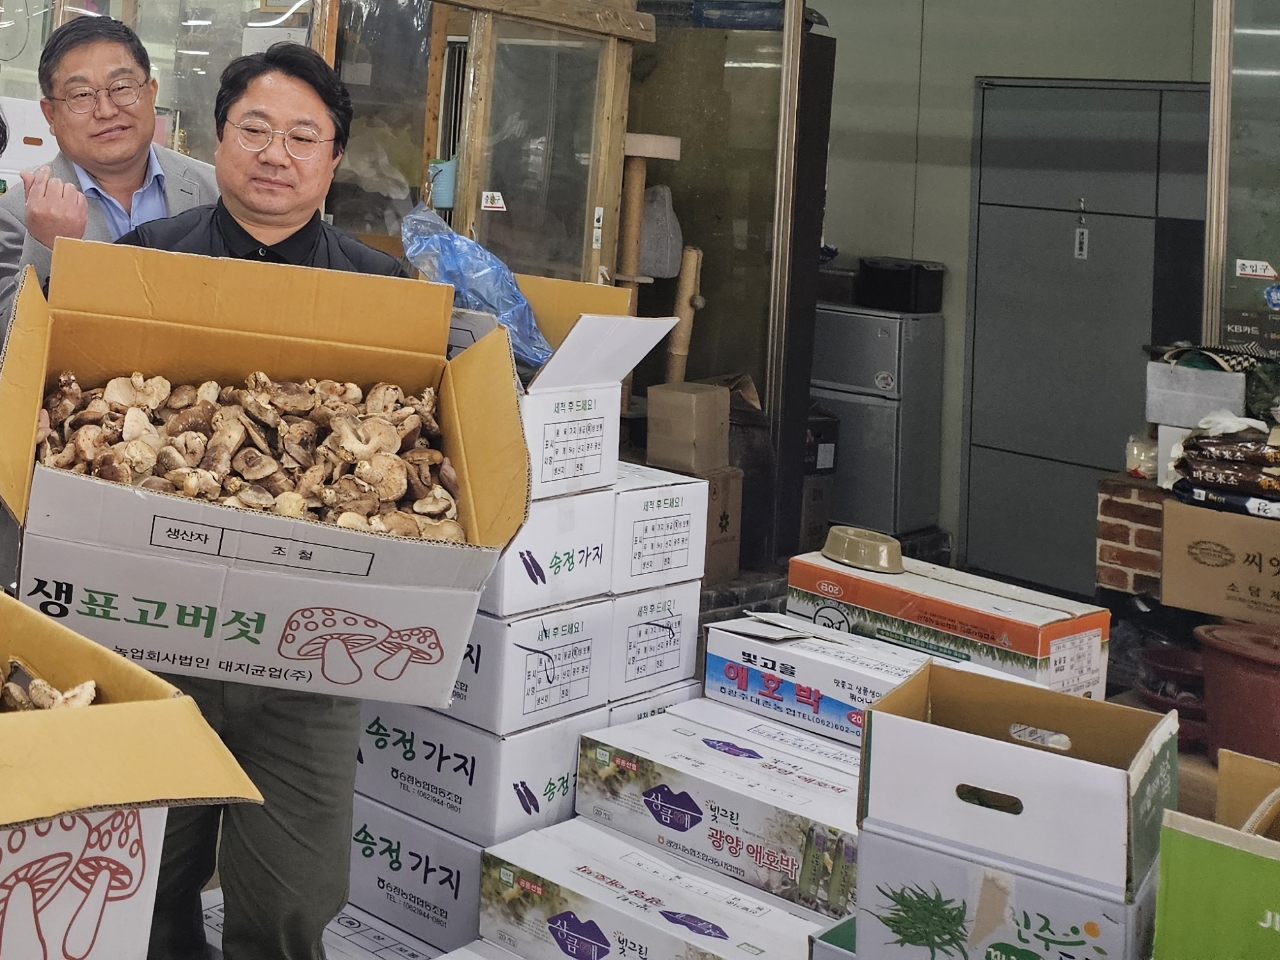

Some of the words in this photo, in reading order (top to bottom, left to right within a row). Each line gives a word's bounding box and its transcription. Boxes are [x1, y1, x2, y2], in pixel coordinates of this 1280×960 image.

[1226, 324, 1260, 336] KB카드
[165, 526, 211, 545] 생산자
[548, 547, 576, 576] 송정
[577, 543, 604, 568] 가지
[217, 659, 314, 684] 대지균업(주)
[740, 650, 797, 679] 빛고을
[723, 661, 824, 715] 애호박
[365, 715, 417, 762] 송정
[422, 740, 476, 787] 가지
[399, 781, 410, 793] TEL
[542, 773, 571, 803] 송정
[709, 803, 741, 827] 빛그린
[352, 823, 403, 873] 송정
[408, 851, 461, 901] 가지
[707, 826, 744, 857] 광양
[746, 843, 799, 880] 애호박
[386, 892, 396, 903] TEL
